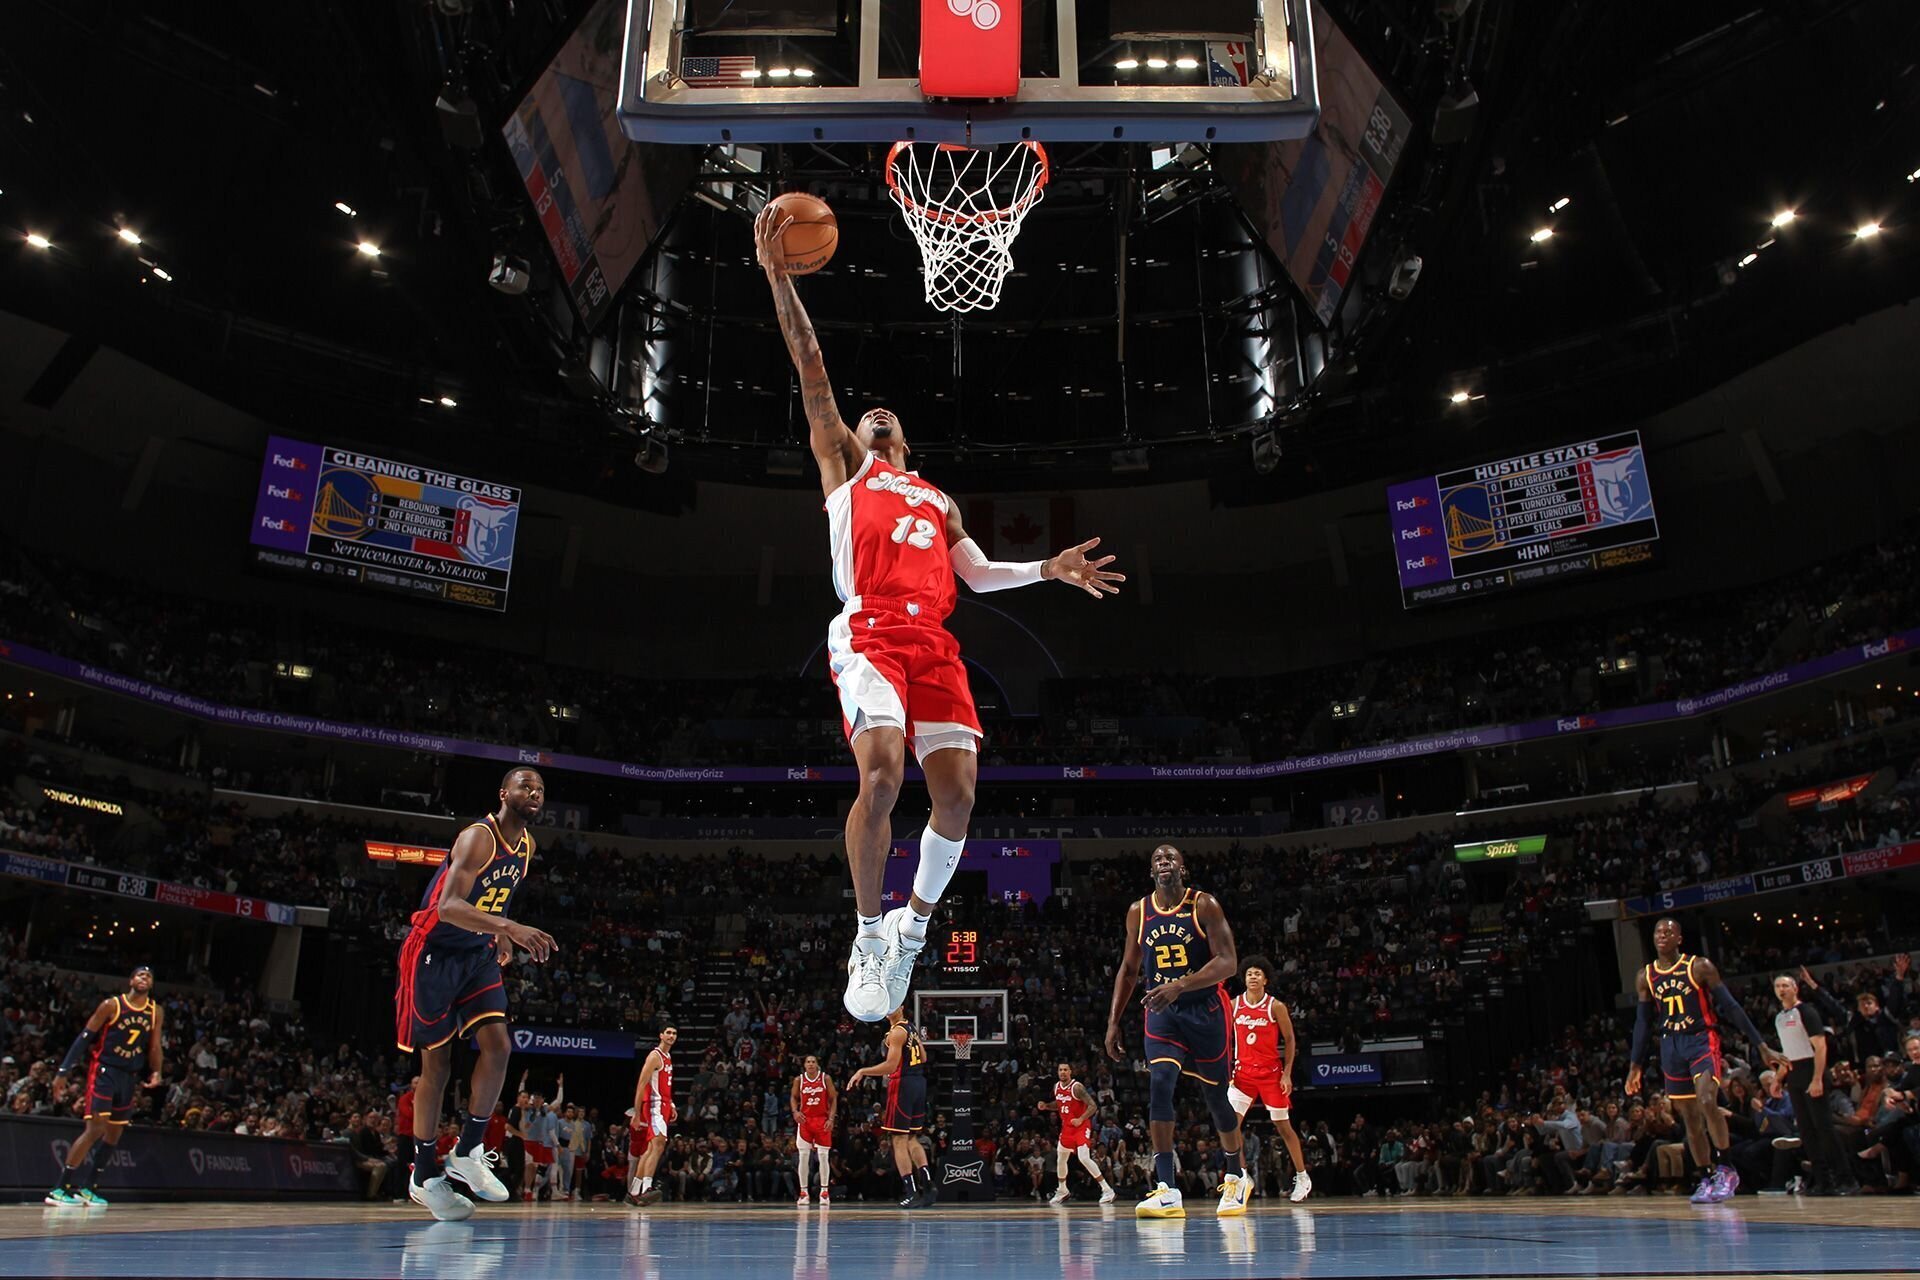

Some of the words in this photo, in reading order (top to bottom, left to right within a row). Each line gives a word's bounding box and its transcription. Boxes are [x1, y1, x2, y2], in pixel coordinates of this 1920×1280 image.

[273, 454, 307, 470] FedEx
[1475, 454, 1541, 480] HUSTLE
[1543, 442, 1599, 465] STATS
[332, 452, 421, 482] CLEANING
[424, 471, 456, 490] THE
[460, 478, 513, 501] GLASS
[1490, 483, 1498, 493] 0
[1508, 471, 1553, 489] FASTBREAK
[1554, 467, 1570, 478] PTS
[267, 484, 302, 501] FedEx
[1526, 483, 1557, 497] ASSISTS
[399, 498, 441, 516] REBOUNDS
[1397, 497, 1429, 511] FedEx
[1520, 493, 1567, 511] TURNOVERS
[388, 508, 404, 521] OFF
[405, 511, 447, 529] REBOUNDS
[1509, 515, 1524, 526] PTS
[1524, 512, 1538, 523] OFF
[1539, 502, 1583, 521] TURNOVERS
[261, 516, 296, 532] FedEx
[384, 521, 400, 533] 2ND
[401, 524, 432, 539] CHANCE
[433, 530, 448, 542] PTS
[891, 514, 937, 550] 12
[1402, 525, 1433, 540] FedEx
[1533, 519, 1562, 534] STEALS
[1517, 544, 1551, 560] HHM
[424, 561, 437, 575] by
[1406, 556, 1438, 570] FedEx
[1561, 557, 1592, 572] DAILY
[412, 580, 442, 593] DAILY
[1862, 635, 1905, 659] FedEx
[1676, 671, 1789, 713] fedex.com/DeliveryGrizz
[79, 664, 103, 681] Take
[104, 675, 140, 694] control
[139, 684, 152, 696] of
[150, 688, 173, 703] your
[173, 694, 216, 717] deliveries
[216, 707, 240, 720] with
[241, 711, 272, 724] FedEx
[273, 715, 314, 732] Delivery
[315, 721, 360, 738] Manager,
[361, 728, 377, 739] it's
[378, 729, 398, 742] free
[399, 733, 409, 743] to
[410, 735, 430, 749] sign
[431, 739, 446, 750] up.
[1556, 715, 1596, 732] FedEx
[518, 749, 552, 765] FedEx
[1152, 766, 1173, 777] Take
[1173, 765, 1205, 777] control
[1205, 765, 1215, 776] of
[1215, 766, 1235, 778] your
[1235, 763, 1275, 776] deliveries
[1276, 759, 1295, 772] with
[1295, 755, 1322, 769] FedEx
[1322, 752, 1357, 769] Delivery
[1358, 745, 1399, 763] Manager,
[1399, 742, 1414, 754] it's
[1415, 740, 1435, 752] free
[1435, 739, 1446, 749] to
[1446, 736, 1466, 751] sign
[1466, 735, 1482, 747] up.
[621, 763, 725, 781] fedex.com/DeliveryGrizz
[787, 768, 822, 781] FedEx
[1063, 767, 1097, 779] FedEx
[80, 797, 123, 815] MINOLTA
[1002, 847, 1032, 857] FedEx
[1485, 842, 1519, 857] Sprite
[1847, 849, 1895, 864] TIMEOUTS:
[1801, 860, 1833, 883] 6:38
[118, 875, 147, 897] 6:38
[475, 887, 511, 912] 22
[881, 891, 904, 900] edEx
[1662, 892, 1674, 909] 5
[234, 897, 252, 916] 13
[952, 931, 977, 943] 6:38
[1145, 923, 1195, 947] GOLDEN
[947, 943, 975, 963] 23
[1155, 944, 1188, 969] 23
[1655, 979, 1693, 1000] GOLDEN
[1663, 995, 1684, 1016] 71
[127, 1029, 140, 1045] 7
[535, 1035, 597, 1049] FANDUEL
[1246, 1032, 1257, 1045] 0
[1331, 1064, 1374, 1075] FANDUEL
[206, 1154, 252, 1172] FANDUEL
[303, 1160, 339, 1176] FANDUEL
[948, 1168, 978, 1178] SONIC
